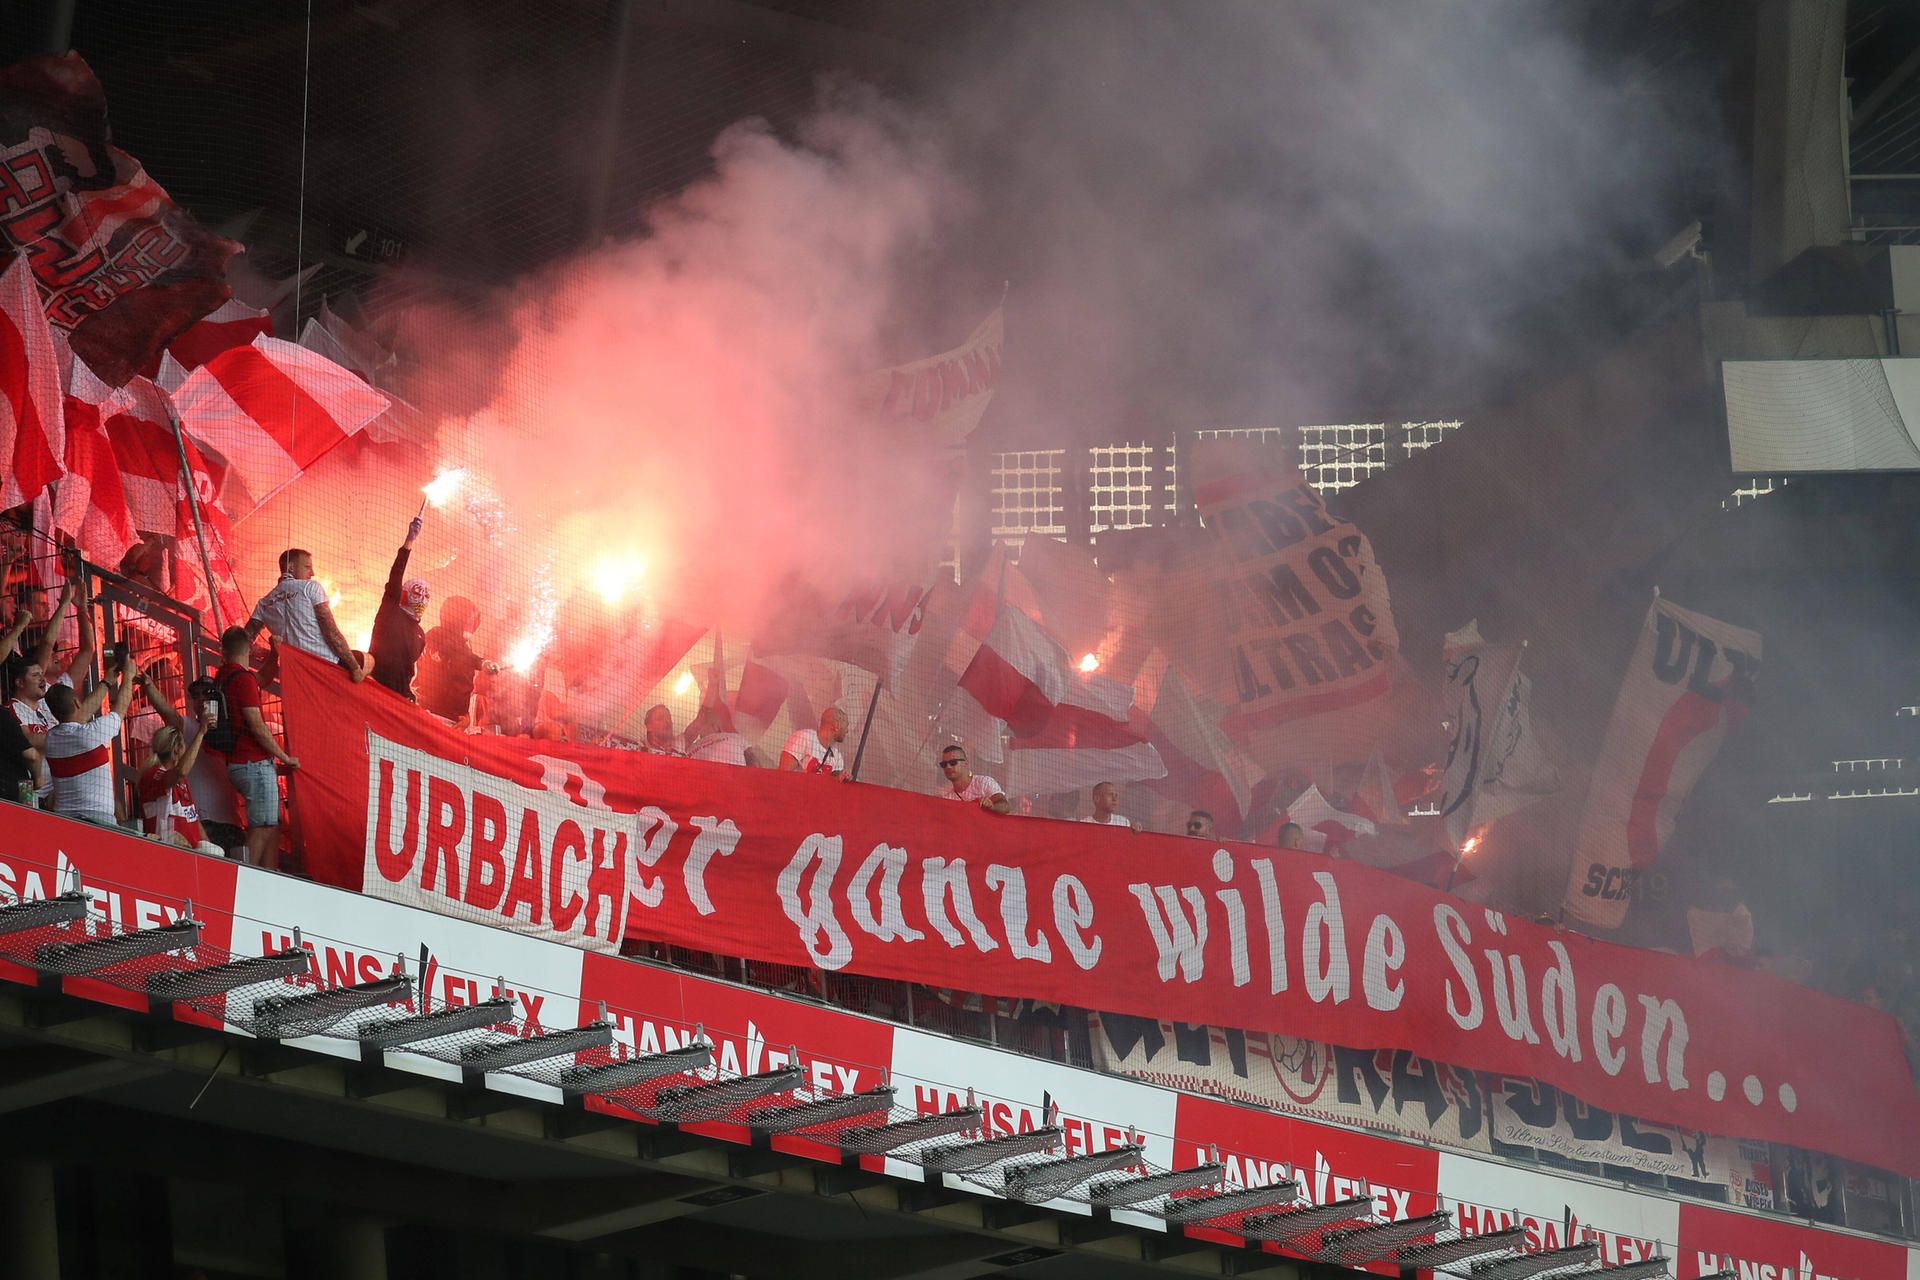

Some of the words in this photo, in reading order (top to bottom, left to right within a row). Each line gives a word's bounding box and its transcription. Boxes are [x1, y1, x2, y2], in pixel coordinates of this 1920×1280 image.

[381, 239, 401, 258] 101
[375, 758, 627, 943] URBACH
[82, 885, 197, 961] FLEX
[777, 833, 1101, 970] ganze
[1128, 849, 1405, 1011] wilde
[606, 1012, 743, 1082] HANSA
[768, 1050, 859, 1102] FEX
